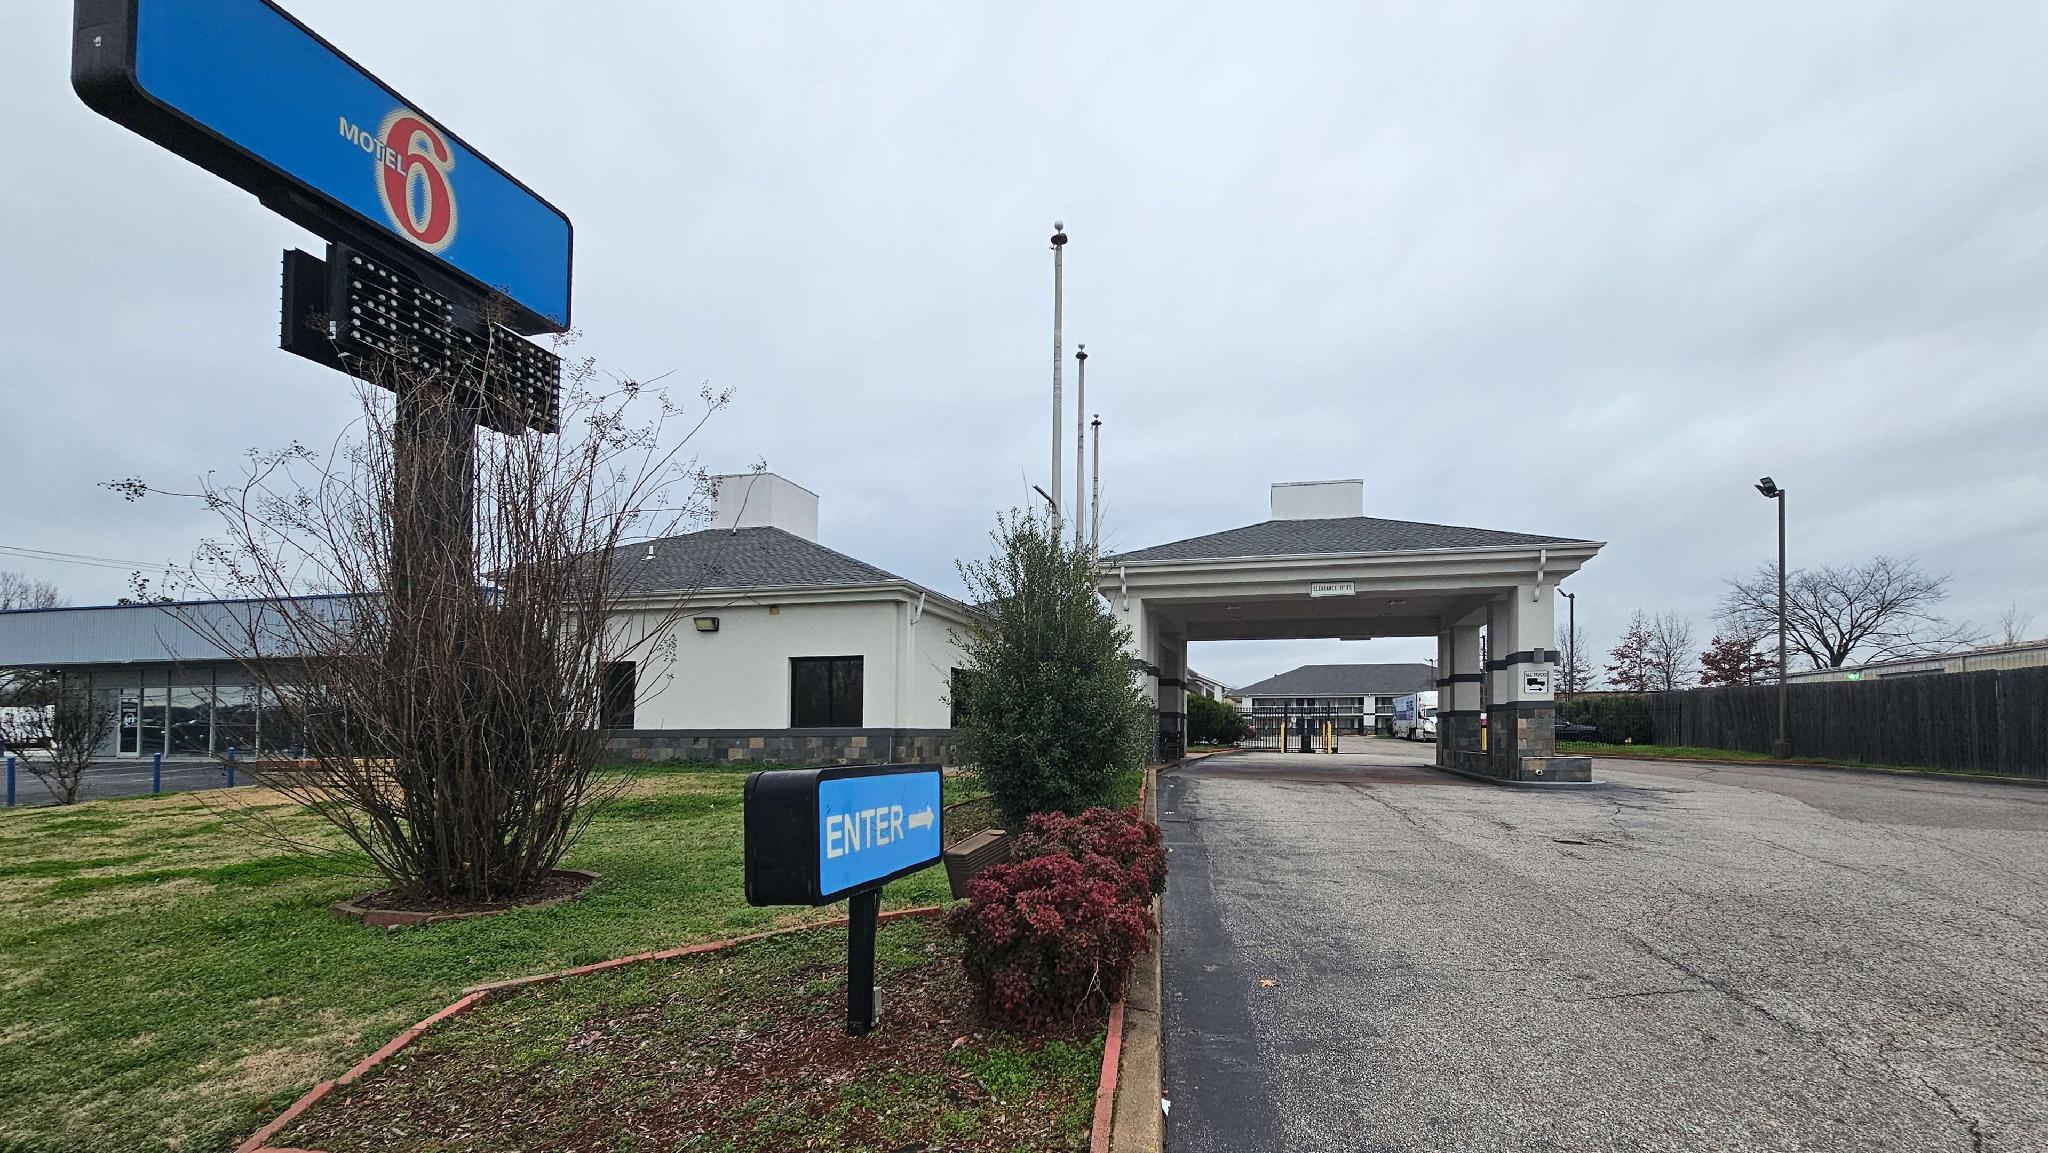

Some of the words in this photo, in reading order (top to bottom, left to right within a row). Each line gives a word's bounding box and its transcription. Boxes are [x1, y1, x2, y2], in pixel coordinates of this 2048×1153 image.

[339, 116, 407, 177] MOTEL
[381, 115, 453, 247] 6
[826, 804, 905, 859] ENTER
